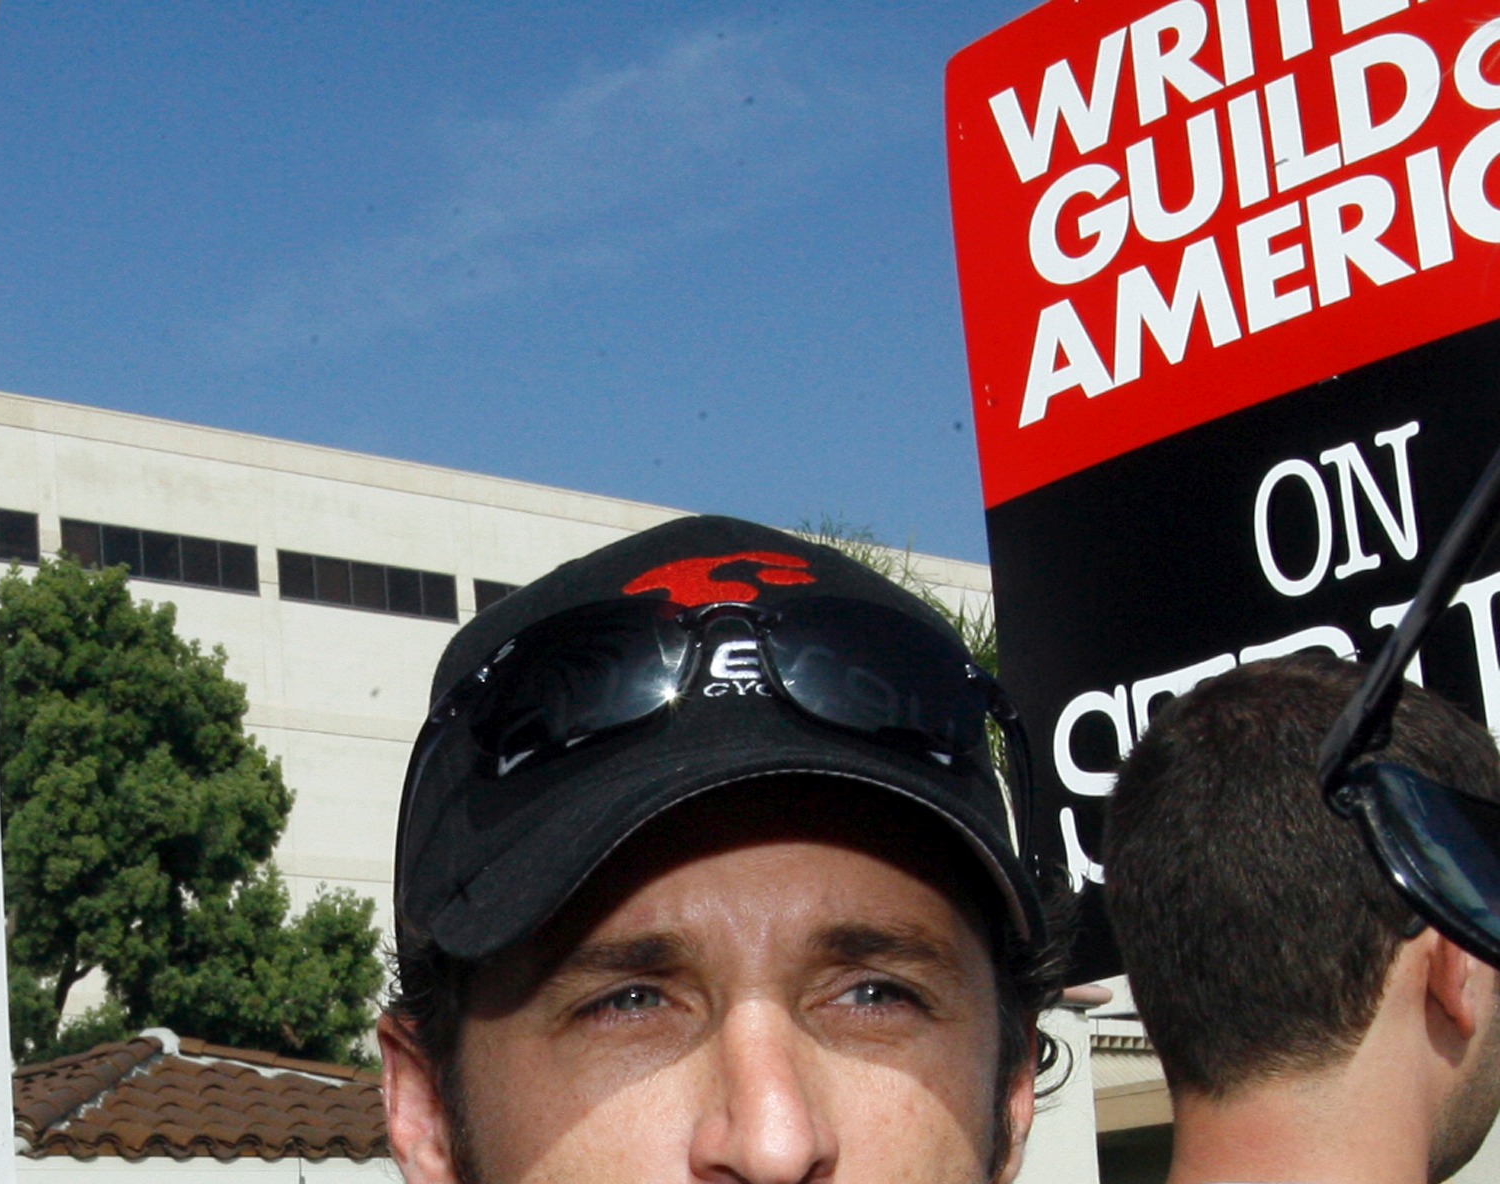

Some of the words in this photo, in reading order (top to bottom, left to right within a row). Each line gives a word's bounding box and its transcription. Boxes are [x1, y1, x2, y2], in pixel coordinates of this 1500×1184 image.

[1019, 118, 1500, 430] AMERIC
[1029, 33, 1442, 285] GUILD
[1254, 422, 1419, 597] ON
